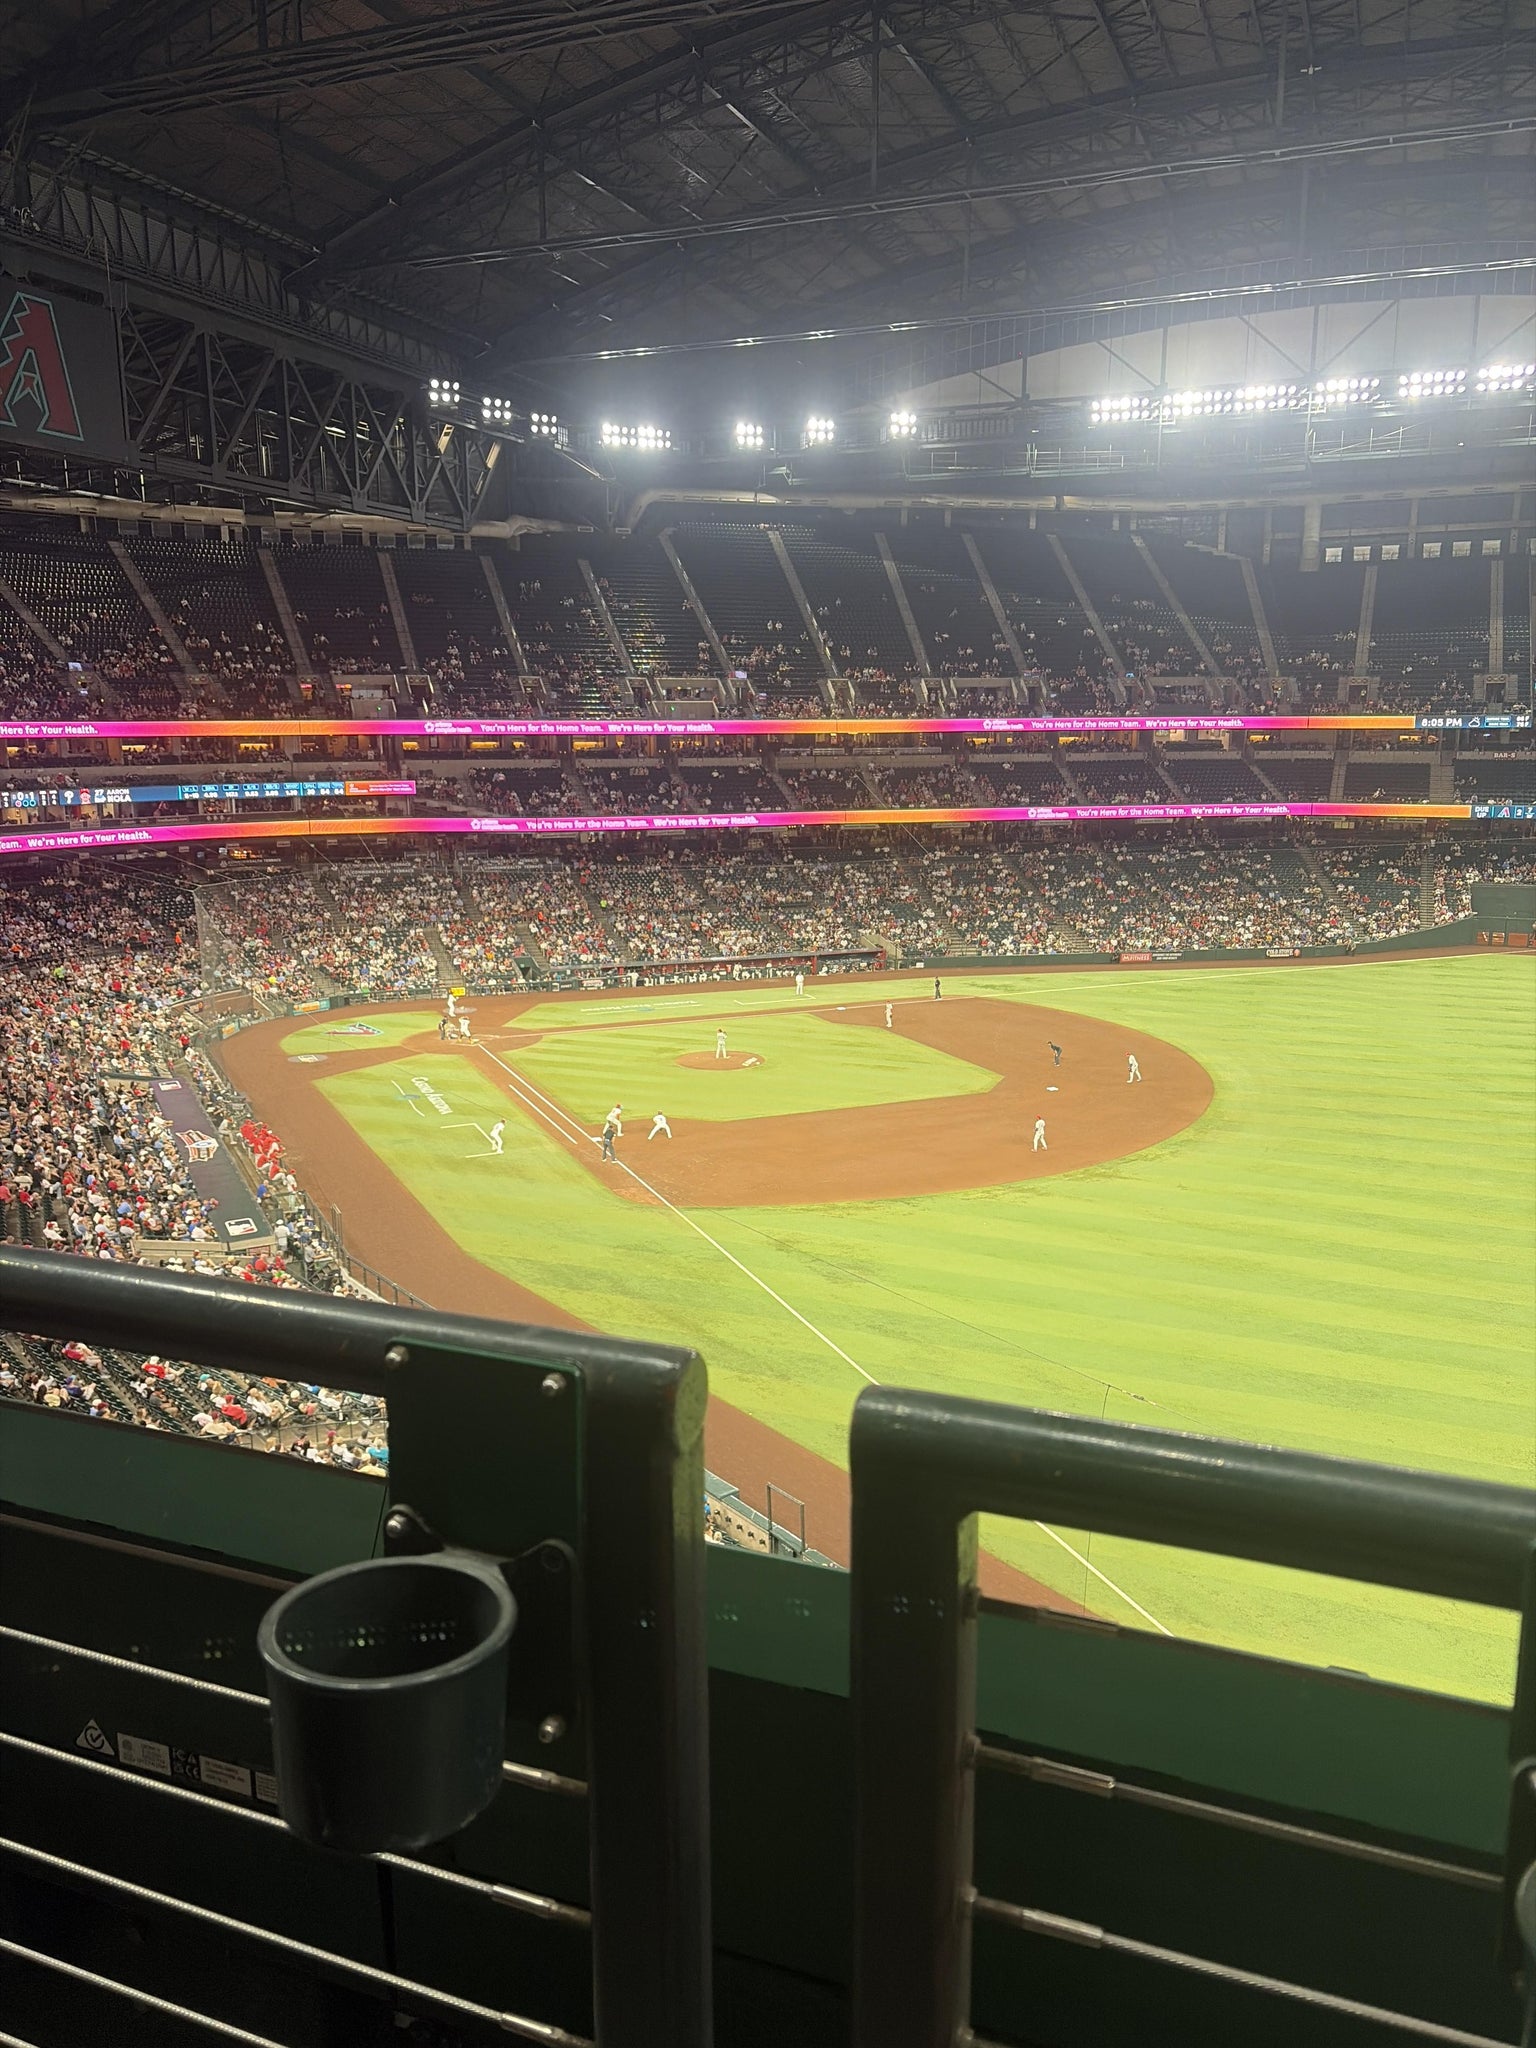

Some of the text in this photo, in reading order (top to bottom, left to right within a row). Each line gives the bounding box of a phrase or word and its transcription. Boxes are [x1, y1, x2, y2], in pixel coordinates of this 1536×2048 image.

[480, 723, 715, 732] You're Here for the Home Team. We're Here for Your Health.
[1031, 718, 1245, 729] You're Here for the Home Team. We're Here for Your Health.
[1421, 718, 1462, 727] 8:05 PM
[0, 724, 98, 735] Here for Your Health.
[107, 794, 132, 803] NOLA
[1077, 805, 1290, 817] You're Here for the Home Team. We're Here for Your Health.
[526, 816, 759, 829] You're Here for the Home Team. We're Here for Your Health.
[28, 837, 55, 847] We're
[57, 836, 79, 846] Here
[80, 834, 93, 844] for
[95, 833, 116, 843] Your
[118, 830, 152, 841] Health.
